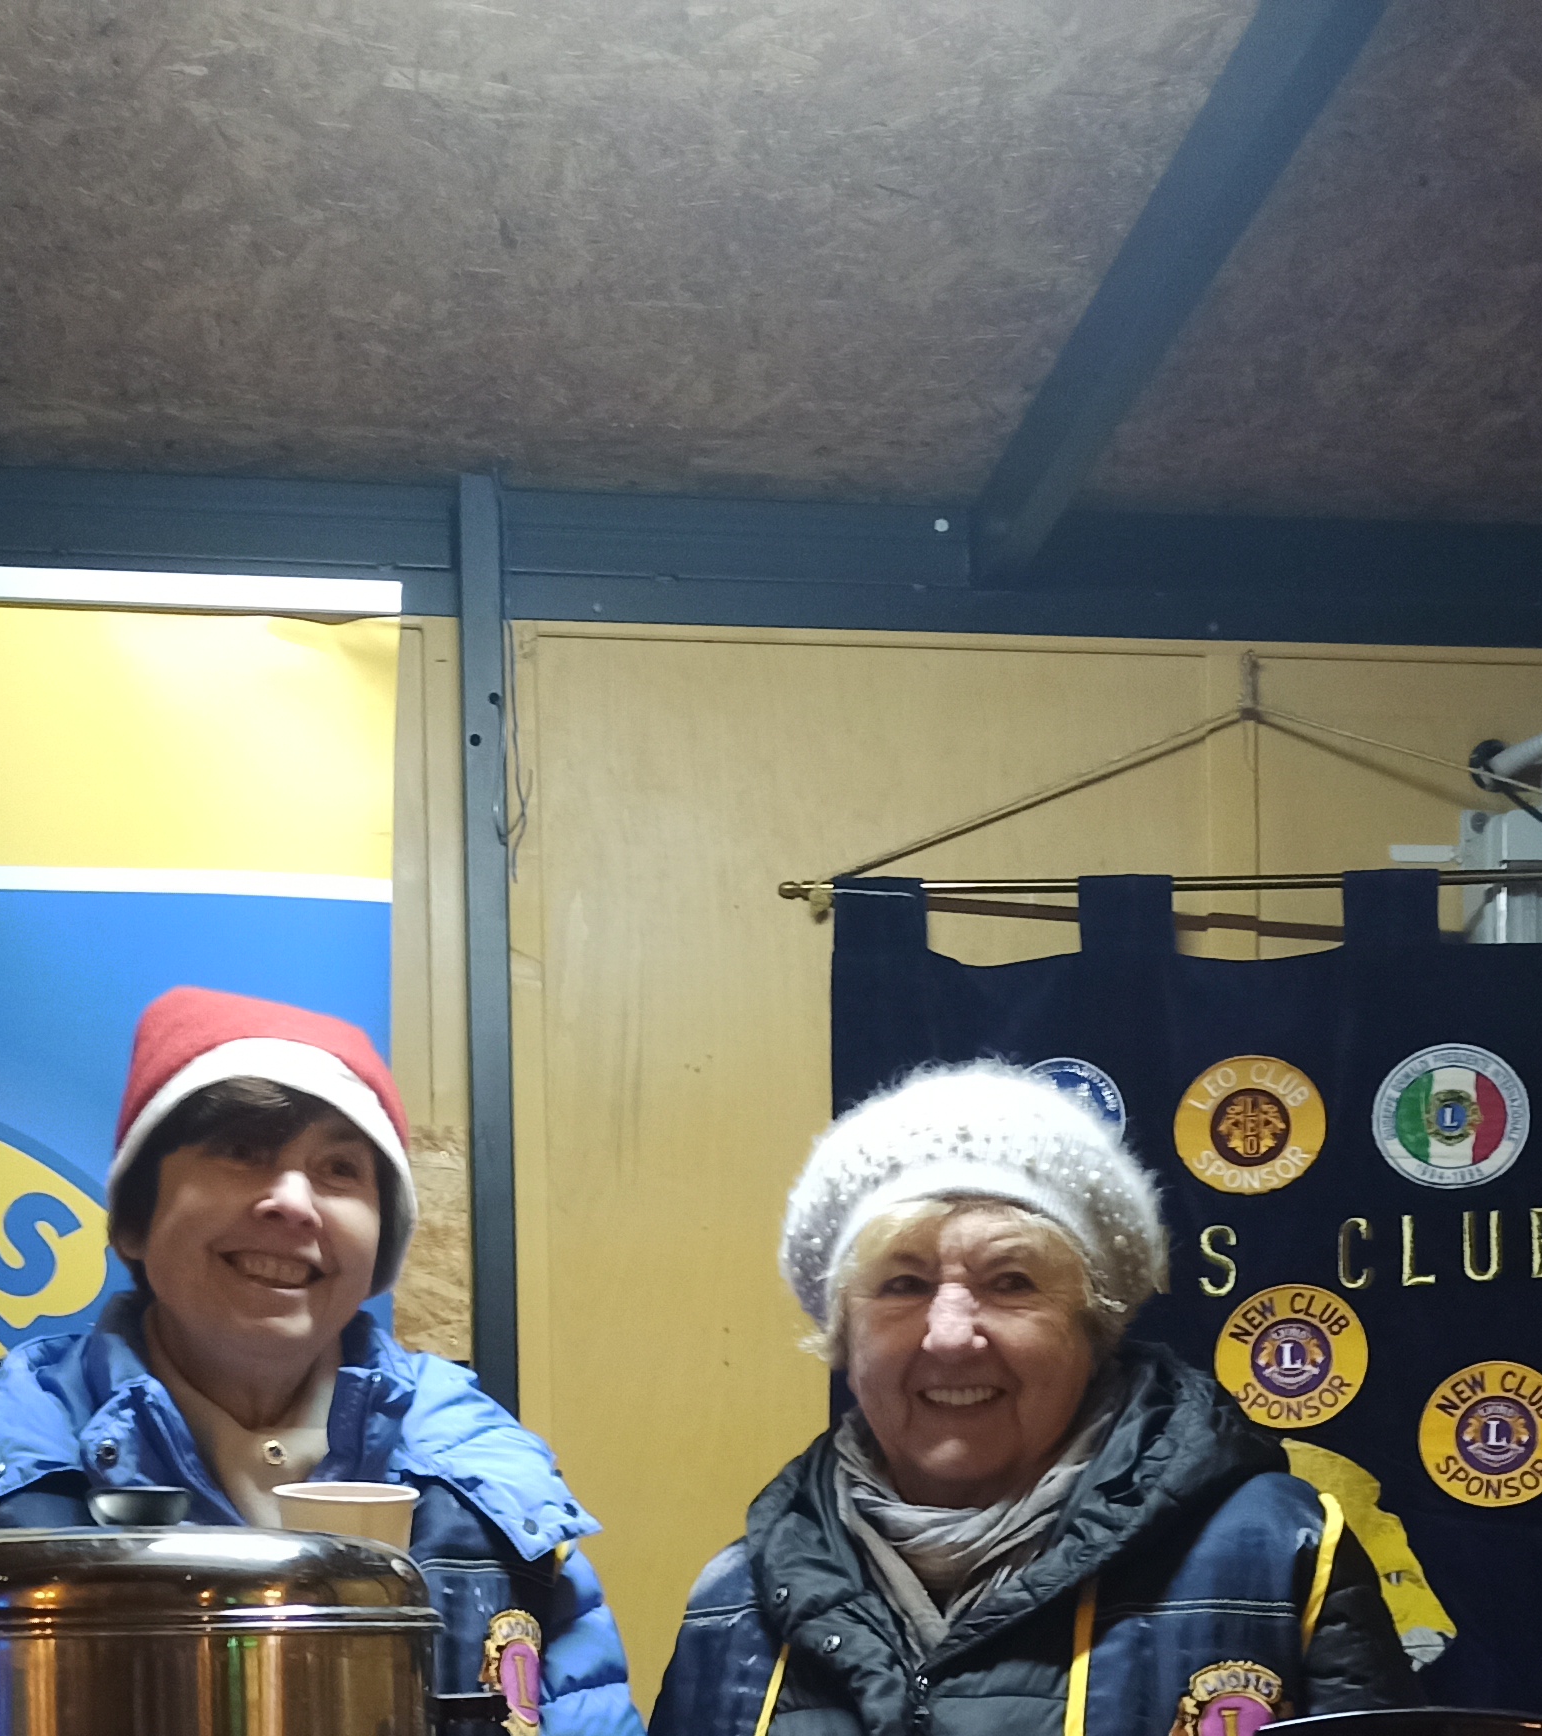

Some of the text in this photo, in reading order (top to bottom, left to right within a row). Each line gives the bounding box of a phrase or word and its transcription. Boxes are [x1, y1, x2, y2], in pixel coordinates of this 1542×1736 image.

[1187, 1063, 1309, 1111] LEO CLUB
[1443, 1107, 1458, 1127] L
[1192, 1146, 1311, 1189] SPONSOR
[1198, 1223, 1238, 1297] S
[1228, 1292, 1351, 1345] NEW CLUB
[1281, 1342, 1302, 1369] L
[1234, 1375, 1353, 1421] SPONSOR
[1435, 1371, 1487, 1418] NEW
[1486, 1420, 1507, 1446] L
[1200, 1669, 1275, 1699] LIONS
